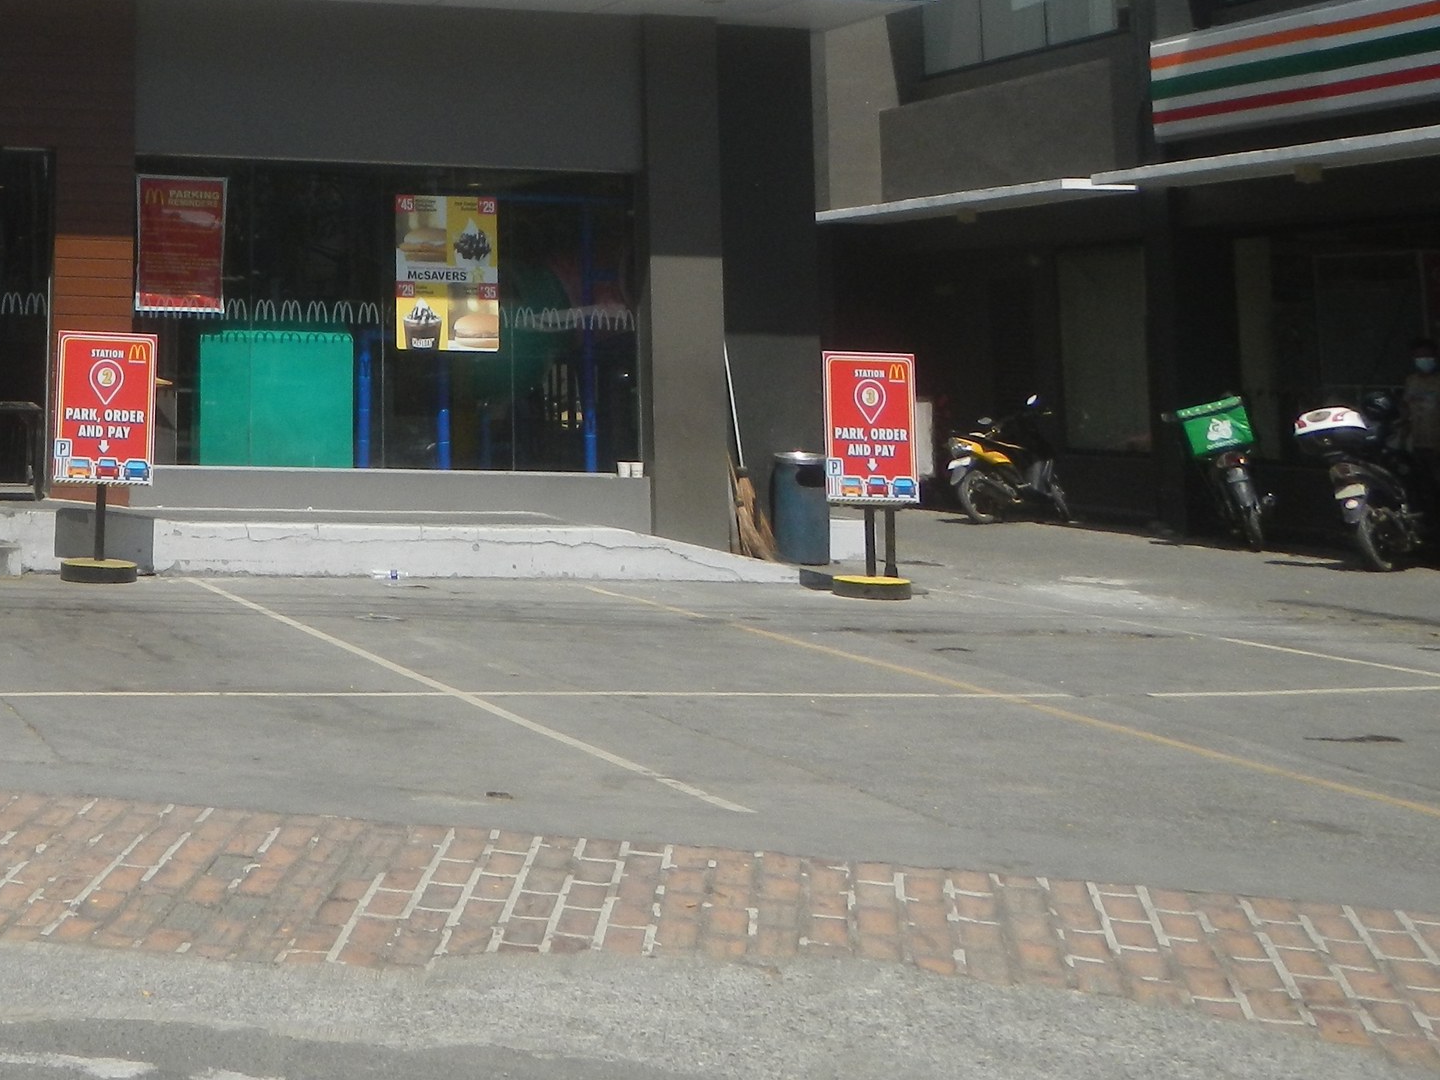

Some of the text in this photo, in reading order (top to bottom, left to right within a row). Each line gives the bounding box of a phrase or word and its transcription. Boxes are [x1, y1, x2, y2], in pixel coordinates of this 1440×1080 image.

[168, 189, 220, 200] PARKING
[167, 199, 219, 208] REMINDERS
[407, 270, 467, 281] McSAVERS
[91, 348, 124, 358] STATION
[854, 369, 885, 378] STATION
[65, 407, 145, 423] PARK, ORDER
[77, 425, 131, 439] AND PAY
[834, 427, 908, 441] PARK, ORDER
[847, 443, 896, 457] AND PAY
